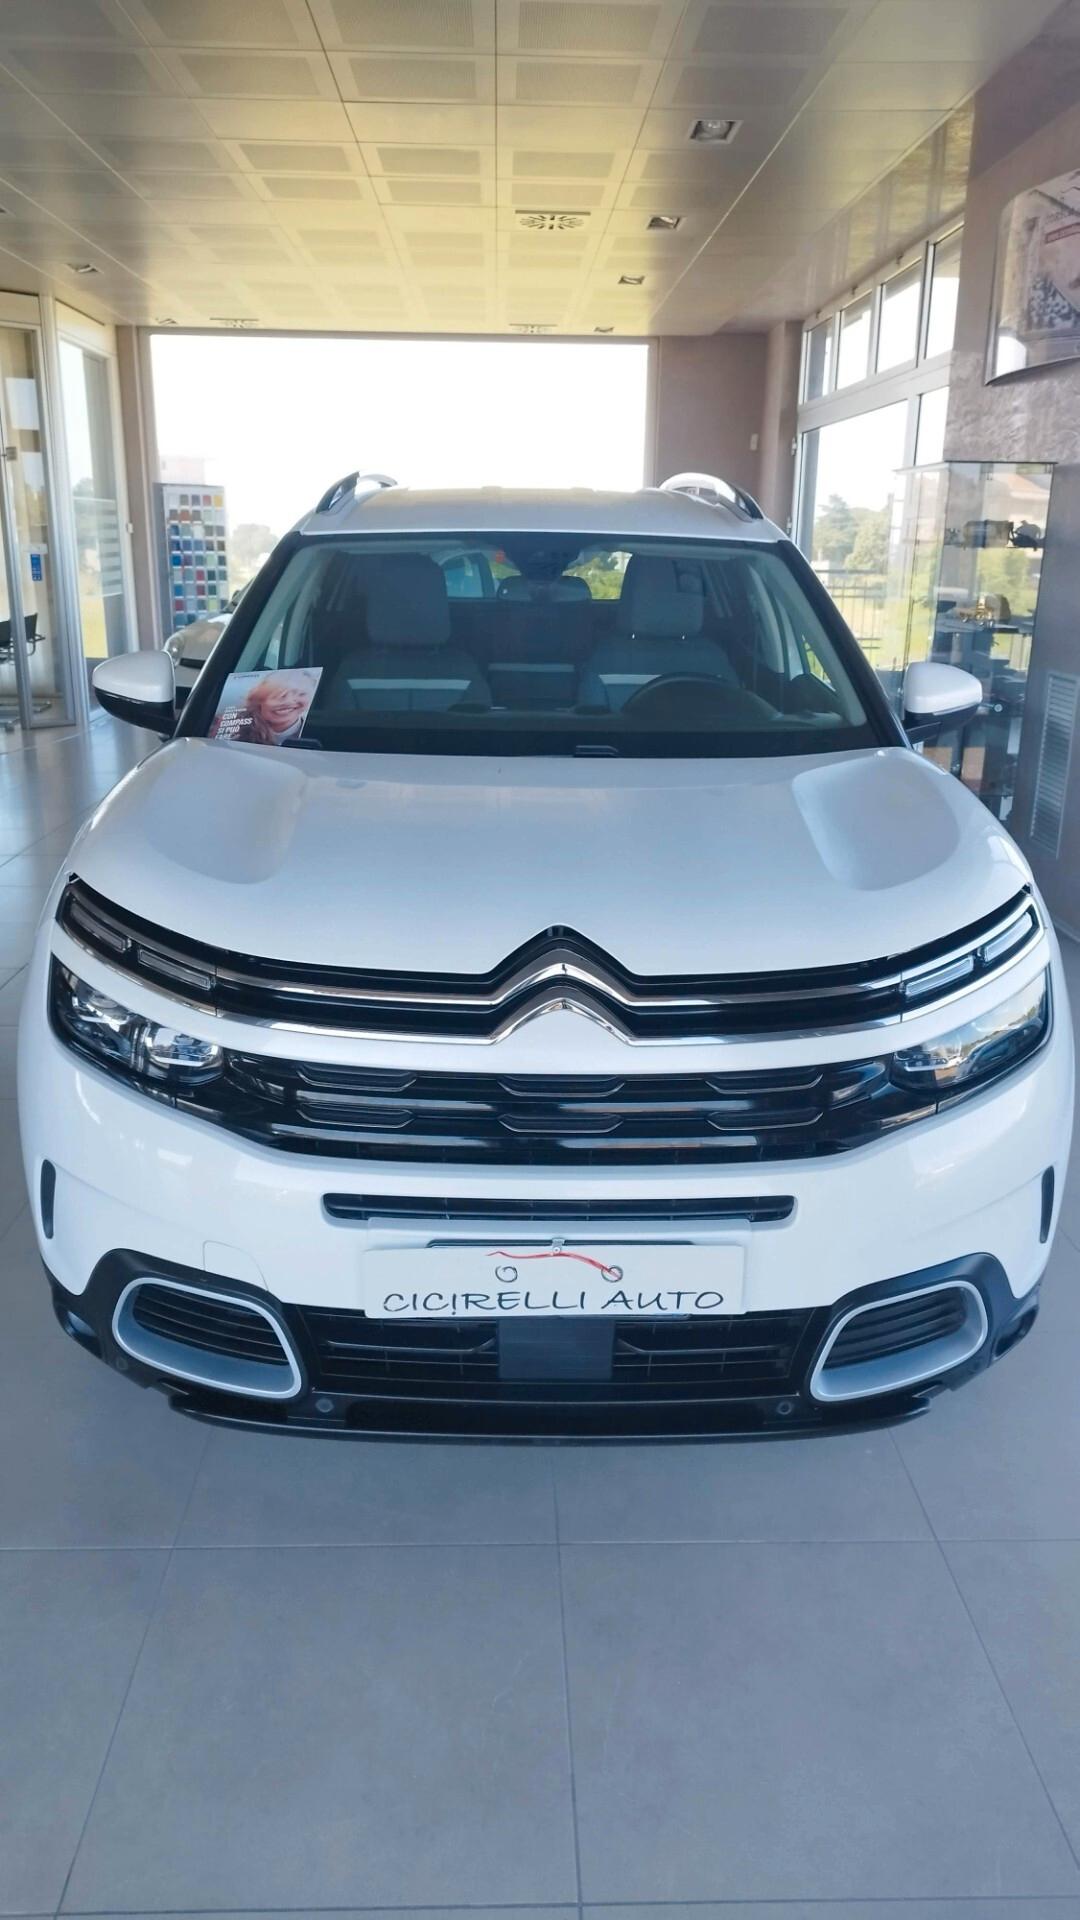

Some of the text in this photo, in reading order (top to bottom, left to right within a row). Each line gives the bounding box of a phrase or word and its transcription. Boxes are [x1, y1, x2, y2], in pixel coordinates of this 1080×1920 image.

[222, 712, 238, 720] CON
[220, 717, 253, 727] COMPASS
[383, 1291, 725, 1316] CICIRELLI AUTO
